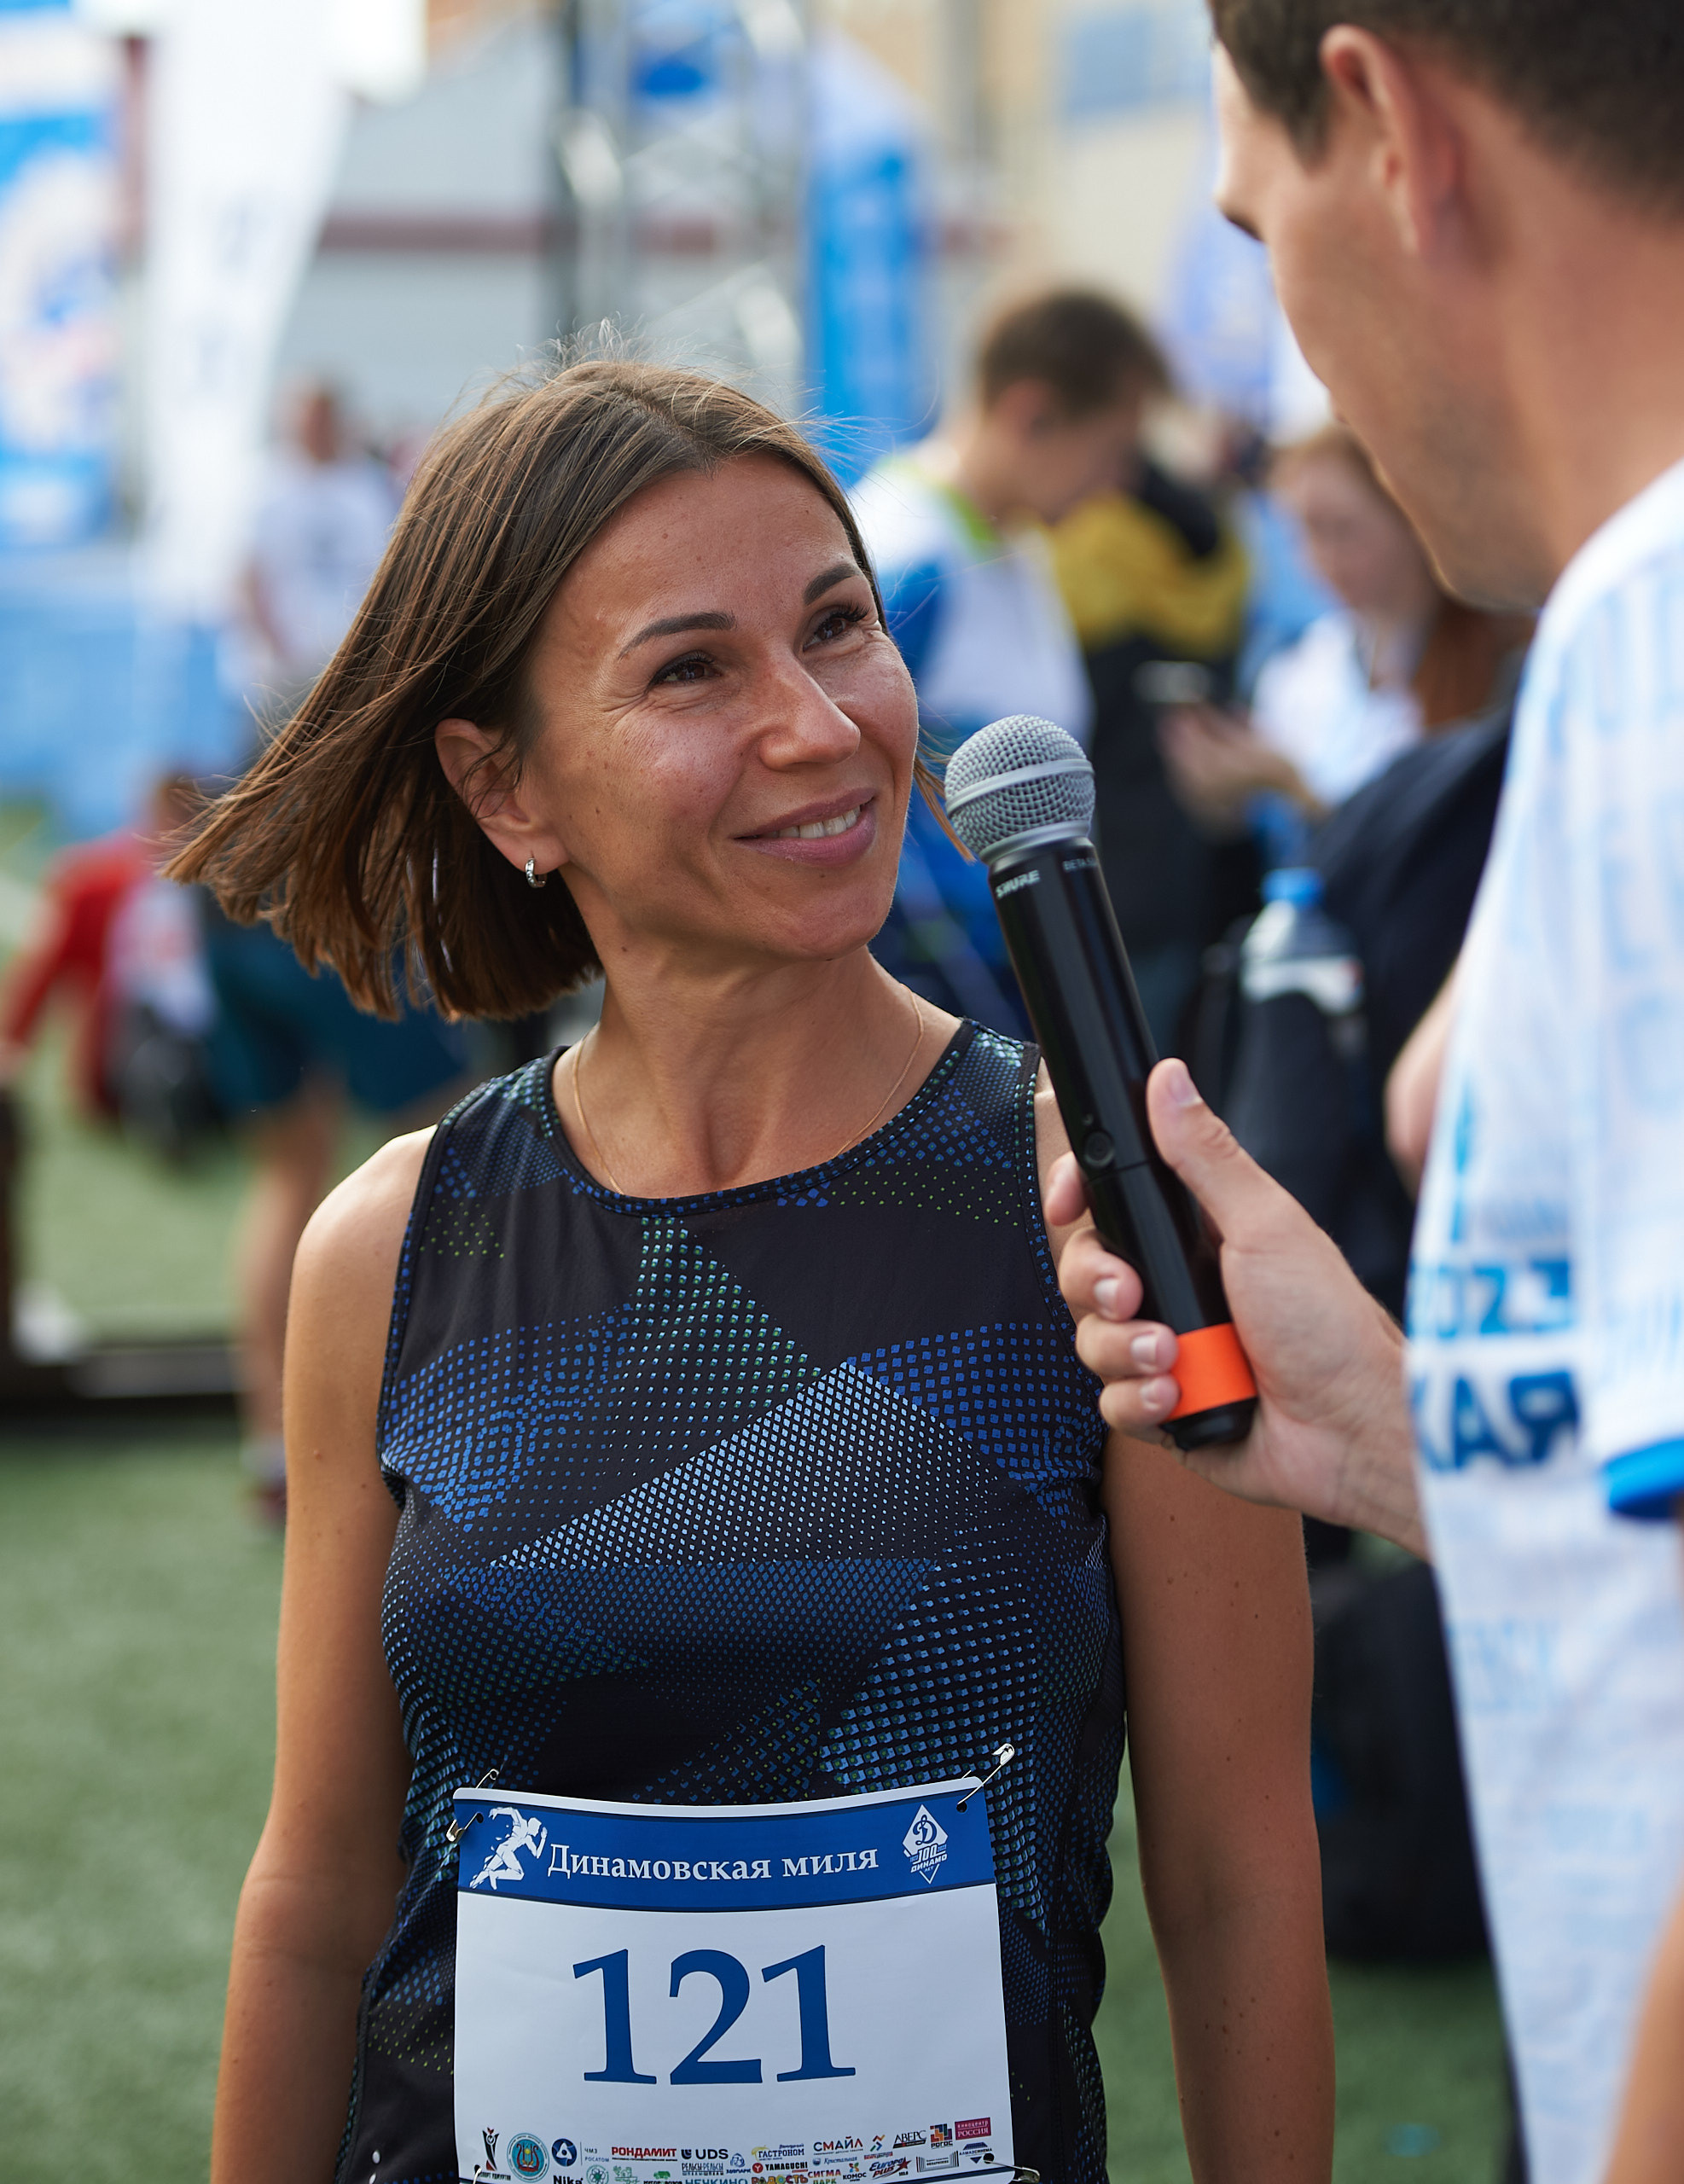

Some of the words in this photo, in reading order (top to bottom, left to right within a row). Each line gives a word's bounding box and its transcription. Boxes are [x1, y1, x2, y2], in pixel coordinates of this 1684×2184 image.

[996, 868, 1040, 899] SHURE
[918, 1844, 938, 1863] 100
[548, 1843, 771, 1881] Динамовская
[781, 1849, 879, 1878] миля
[910, 1854, 947, 1873] ДИНАМО
[573, 1944, 857, 2085] 121
[895, 2130, 927, 2143] АВЕРС
[958, 2128, 989, 2137] РОССИЯ
[813, 2136, 863, 2152] СМАЙЛ
[612, 2146, 677, 2158] РОНДАМИТ
[695, 2149, 729, 2159] UDS
[758, 2148, 804, 2158] ГАСТРОНОМ
[765, 2162, 808, 2170] YAMAGUCHI
[752, 2174, 808, 2184] РАДОСТЬ
[808, 2169, 841, 2179] СИГМА
